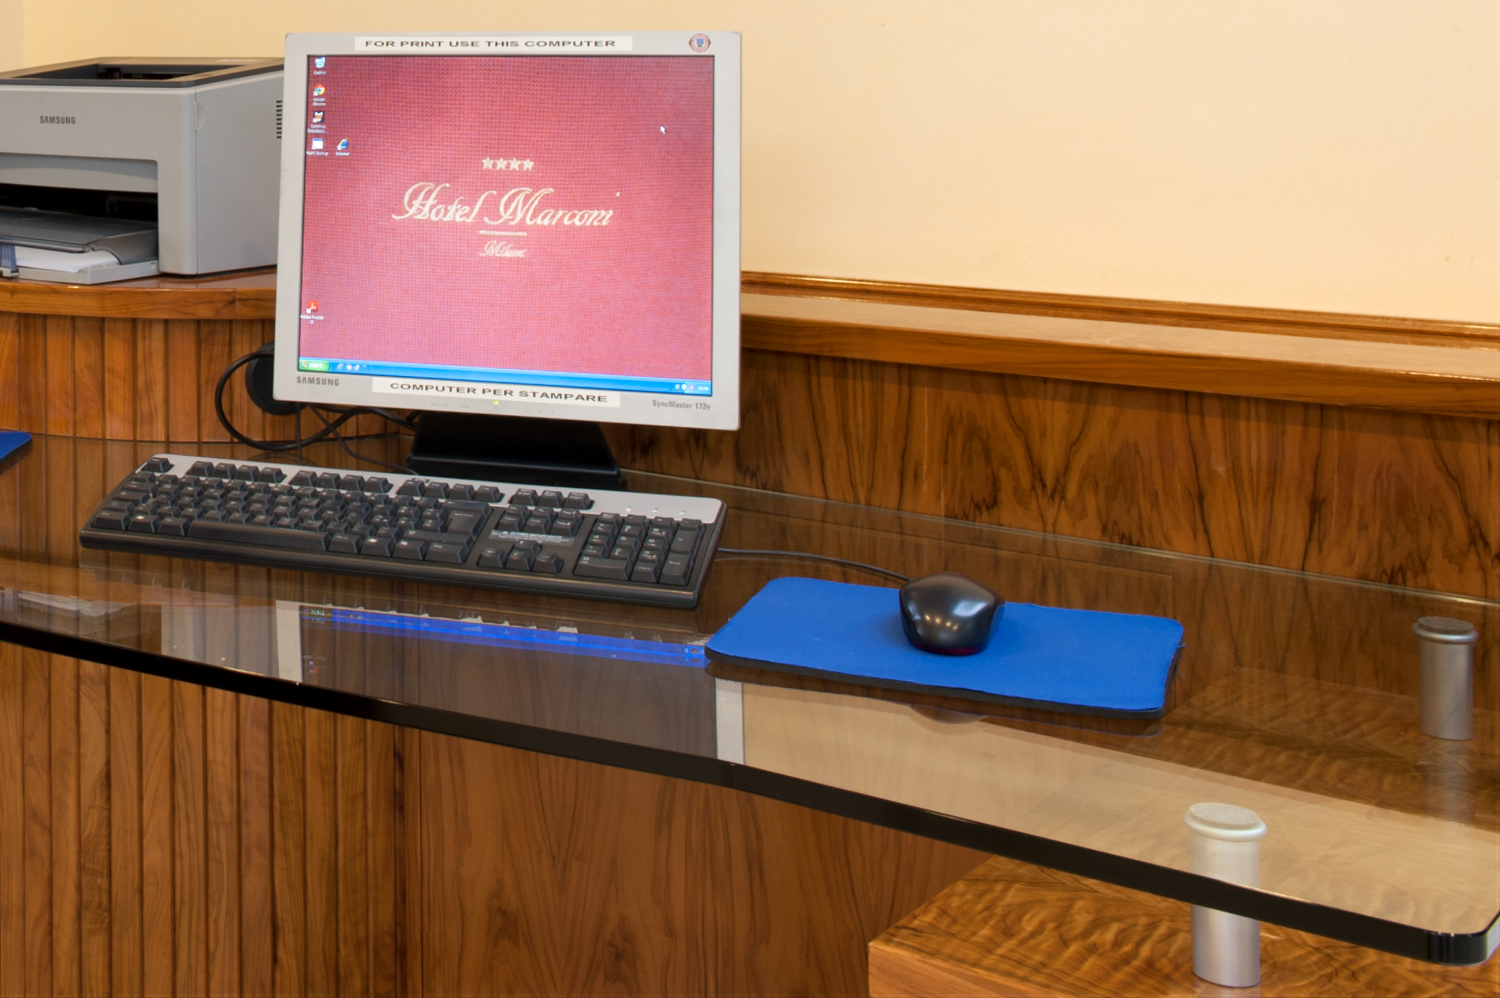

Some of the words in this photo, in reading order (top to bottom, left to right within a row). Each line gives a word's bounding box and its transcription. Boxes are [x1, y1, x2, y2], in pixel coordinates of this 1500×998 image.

[40, 115, 76, 125] SAMSUNG
[391, 181, 497, 223] Hotel
[484, 187, 620, 226] Marconi
[296, 376, 340, 386] SAMSUNG
[390, 382, 477, 394] COMPUTER
[482, 387, 514, 397] PER
[519, 390, 608, 403] STAMPARE
[652, 399, 693, 409] SyncMaster
[695, 402, 711, 410] 172v
